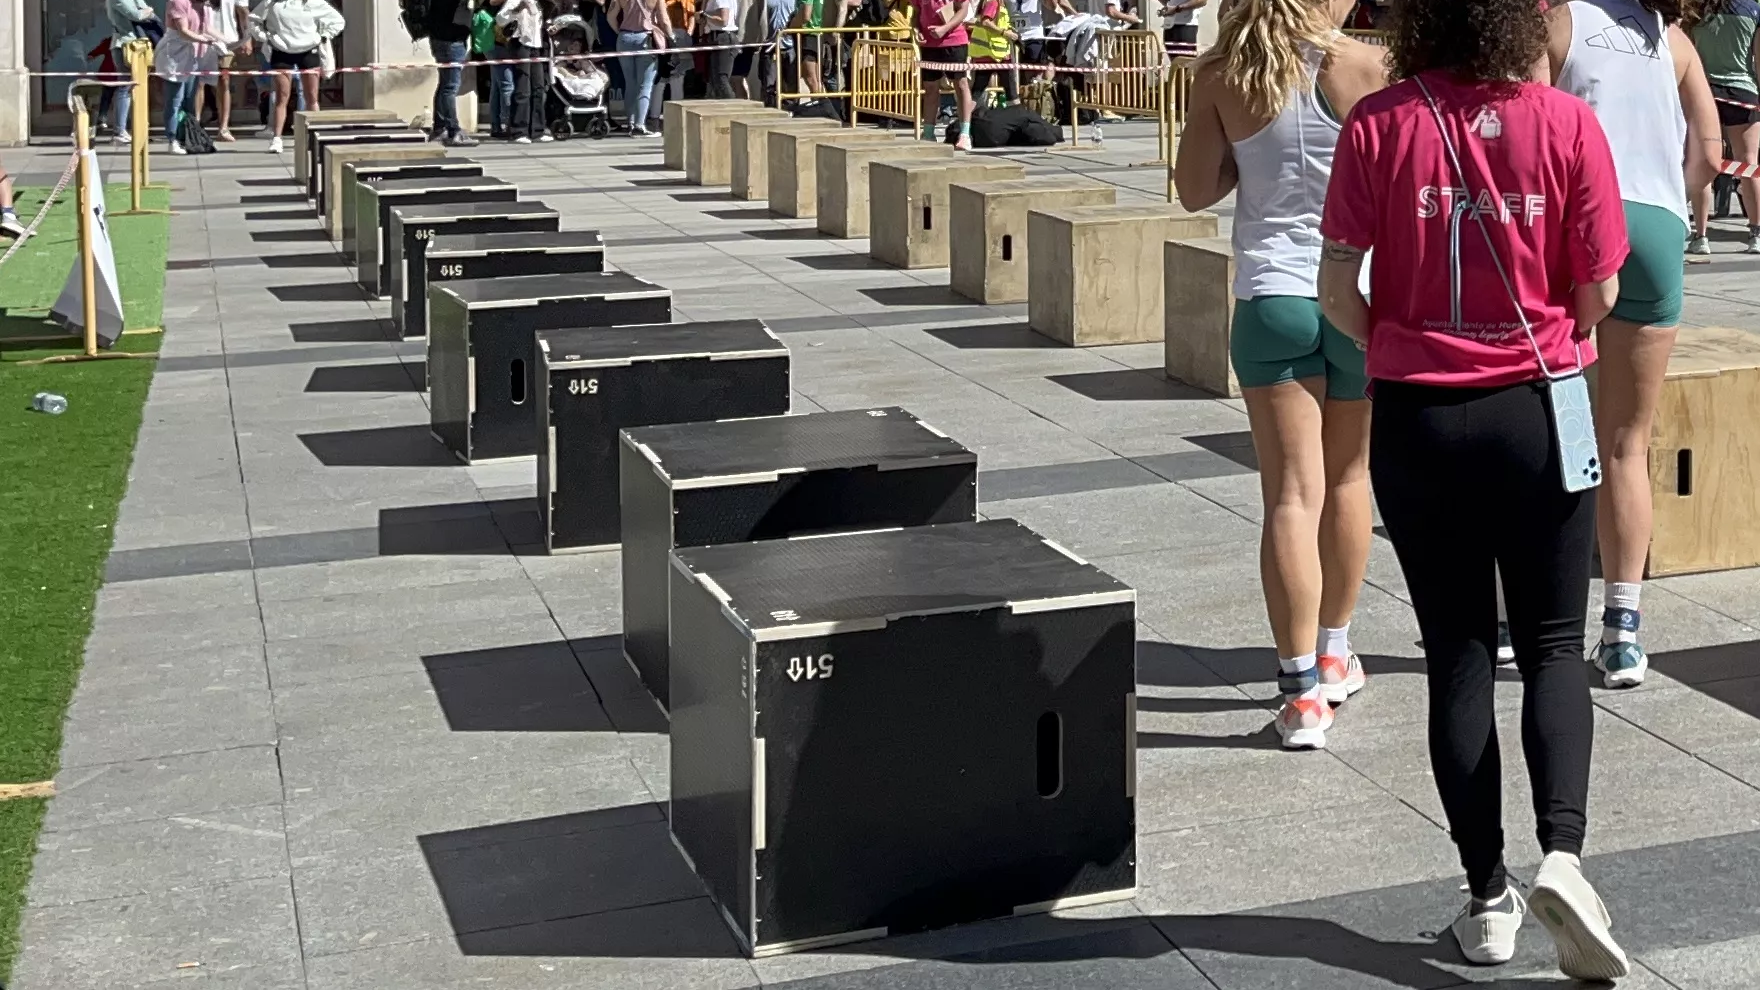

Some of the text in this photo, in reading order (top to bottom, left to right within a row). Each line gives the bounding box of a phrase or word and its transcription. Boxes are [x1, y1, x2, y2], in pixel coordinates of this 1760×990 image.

[1418, 185, 1546, 227] STAFF
[579, 378, 598, 394] 51
[805, 653, 835, 680] 51
